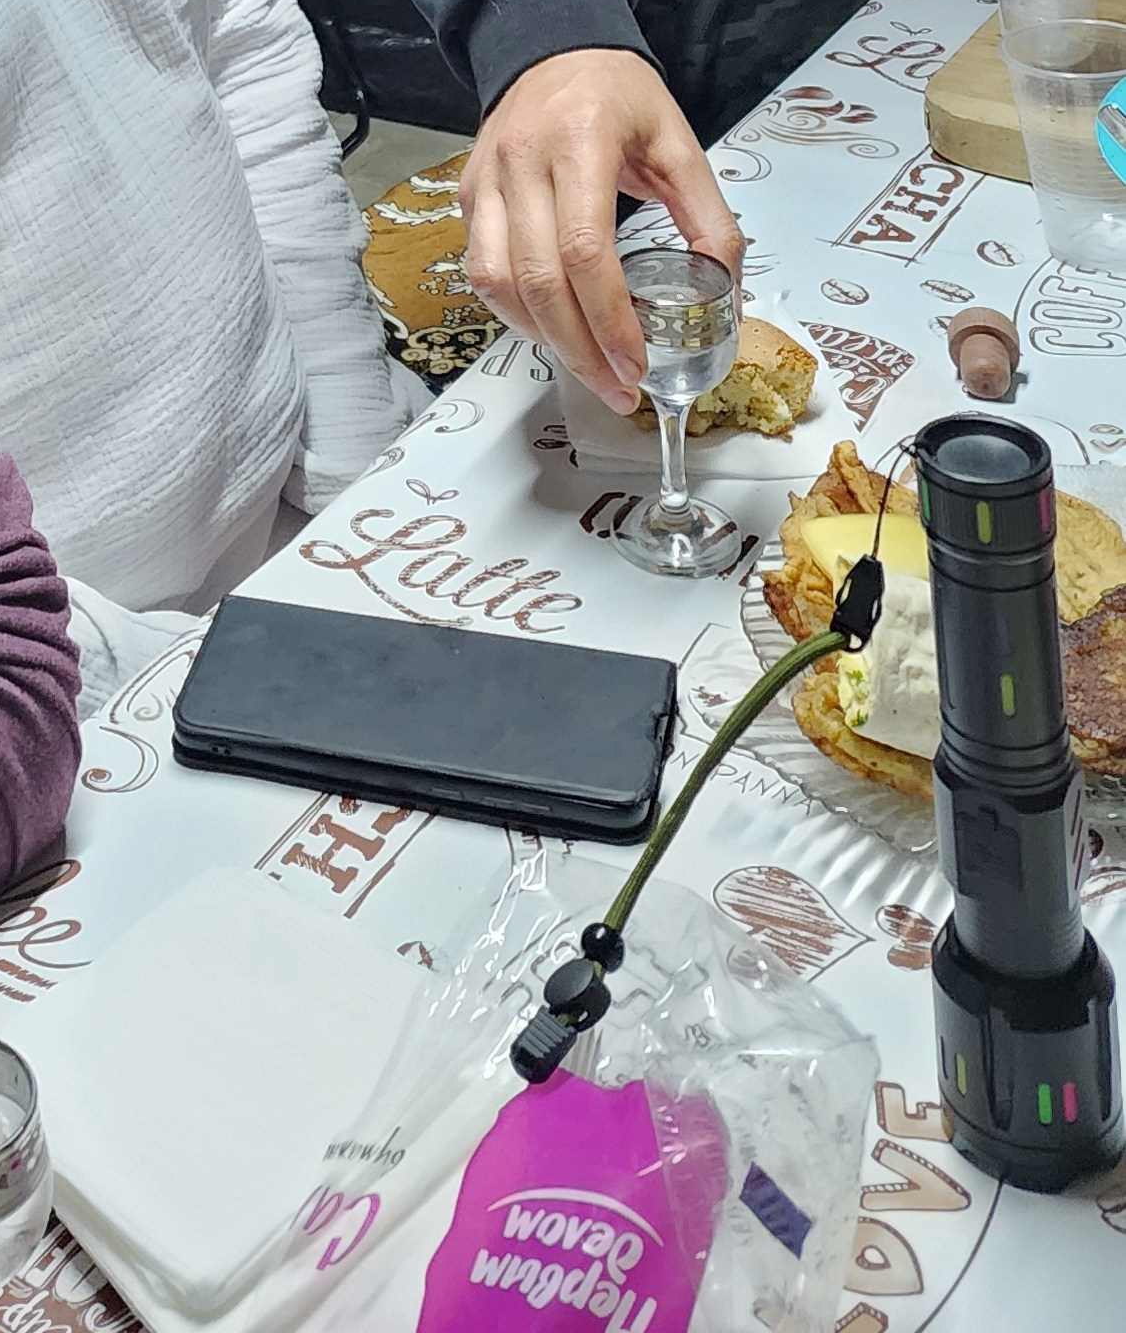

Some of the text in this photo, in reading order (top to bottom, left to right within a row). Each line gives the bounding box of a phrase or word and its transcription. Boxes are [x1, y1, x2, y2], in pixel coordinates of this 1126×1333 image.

[850, 161, 966, 246] CHA
[298, 508, 583, 634] Latte
[710, 762, 815, 817] PANNA
[504, 1204, 645, 1284] делом
[470, 1248, 658, 1333] Первым
